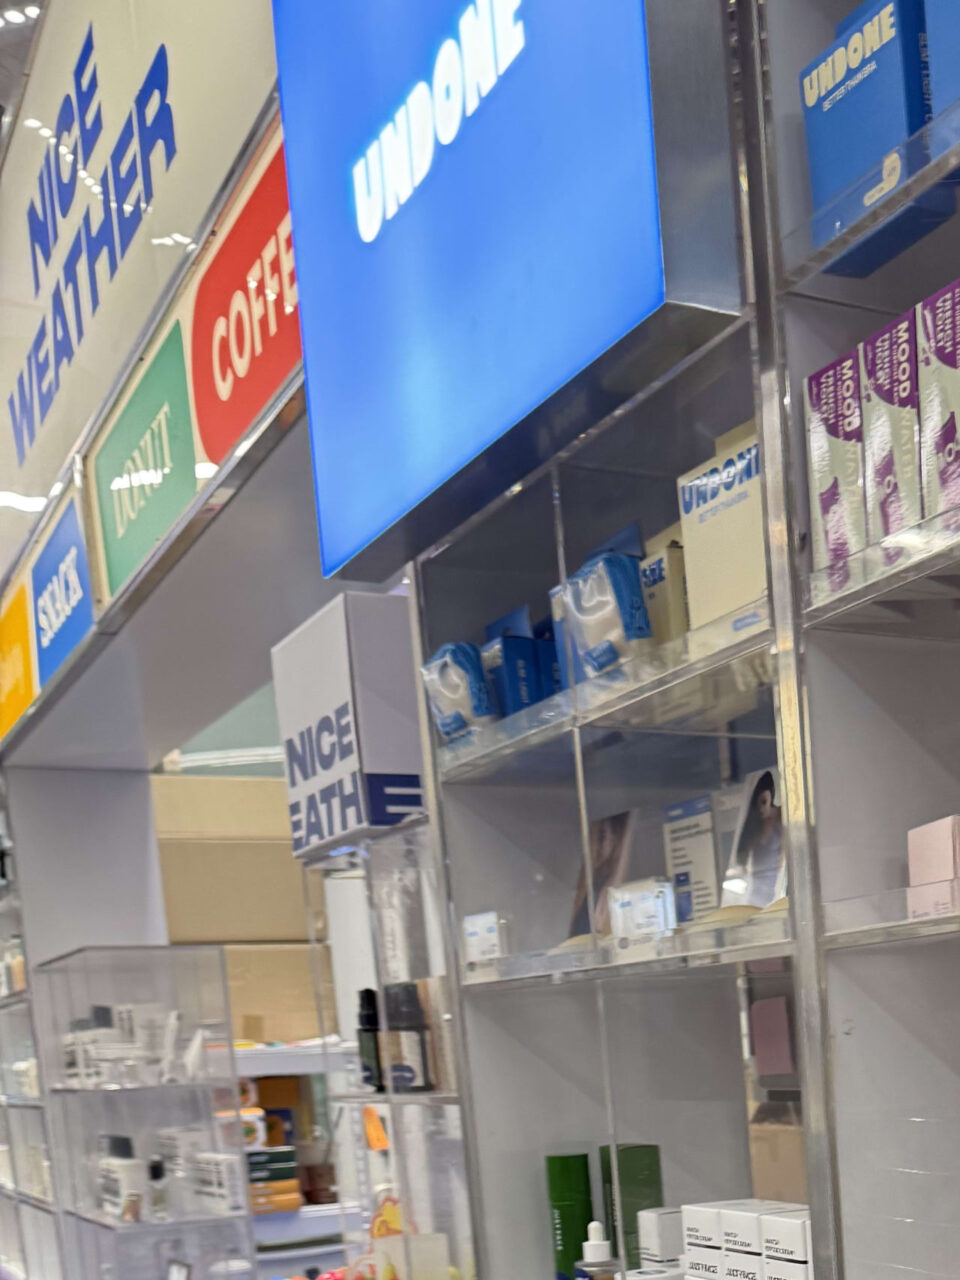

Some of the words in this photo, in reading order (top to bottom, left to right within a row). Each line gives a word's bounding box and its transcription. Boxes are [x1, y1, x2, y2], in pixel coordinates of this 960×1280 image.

[803, 2, 897, 107] UNDONE
[27, 21, 103, 299] NICE
[352, 0, 526, 243] UNDONE
[8, 43, 177, 468] WEATHER
[897, 321, 910, 398] MOOD
[936, 298, 945, 347] VIOLET
[943, 292, 953, 354] FRENCH
[841, 358, 856, 432] MOOD
[285, 701, 354, 789] NICE
